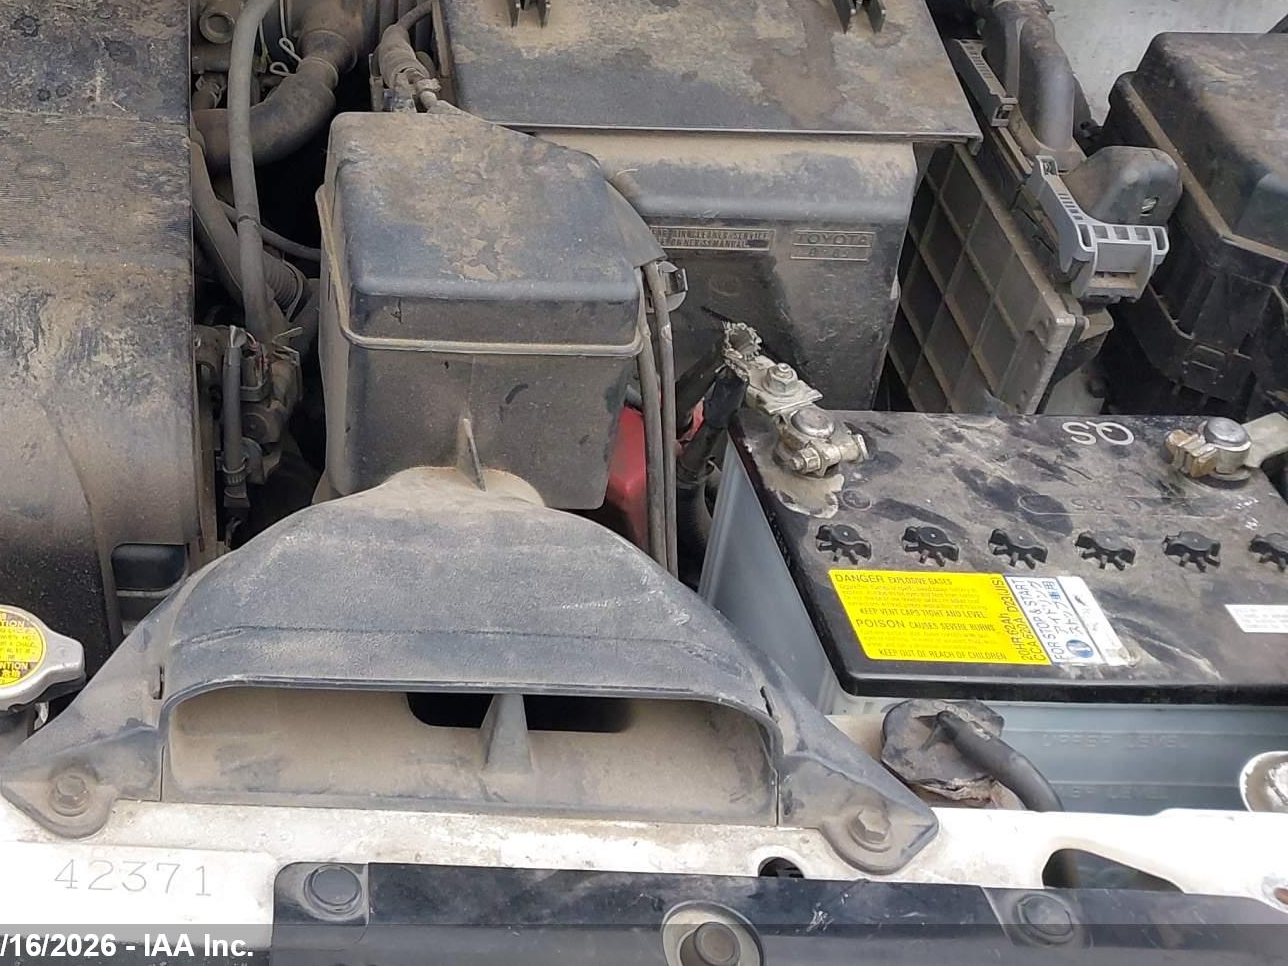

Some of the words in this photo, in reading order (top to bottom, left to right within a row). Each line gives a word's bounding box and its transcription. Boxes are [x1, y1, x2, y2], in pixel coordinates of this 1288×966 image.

[798, 233, 869, 244] TOYOTA
[834, 573, 885, 584] DANGER
[888, 576, 926, 585] EXPLOSIVE
[1011, 577, 1038, 608] START
[859, 607, 878, 615] KEEP
[879, 608, 900, 616] VENT
[855, 618, 906, 628] POISON
[908, 620, 939, 630] CAUSES
[1033, 616, 1057, 640] STOP
[878, 648, 898, 657] KEEP
[968, 651, 1008, 660] CHILDREN
[1048, 640, 1069, 661] FOR
[1042, 733, 1112, 748] UPPER
[1127, 734, 1192, 749] LEVEL
[54, 858, 213, 897] 42371
